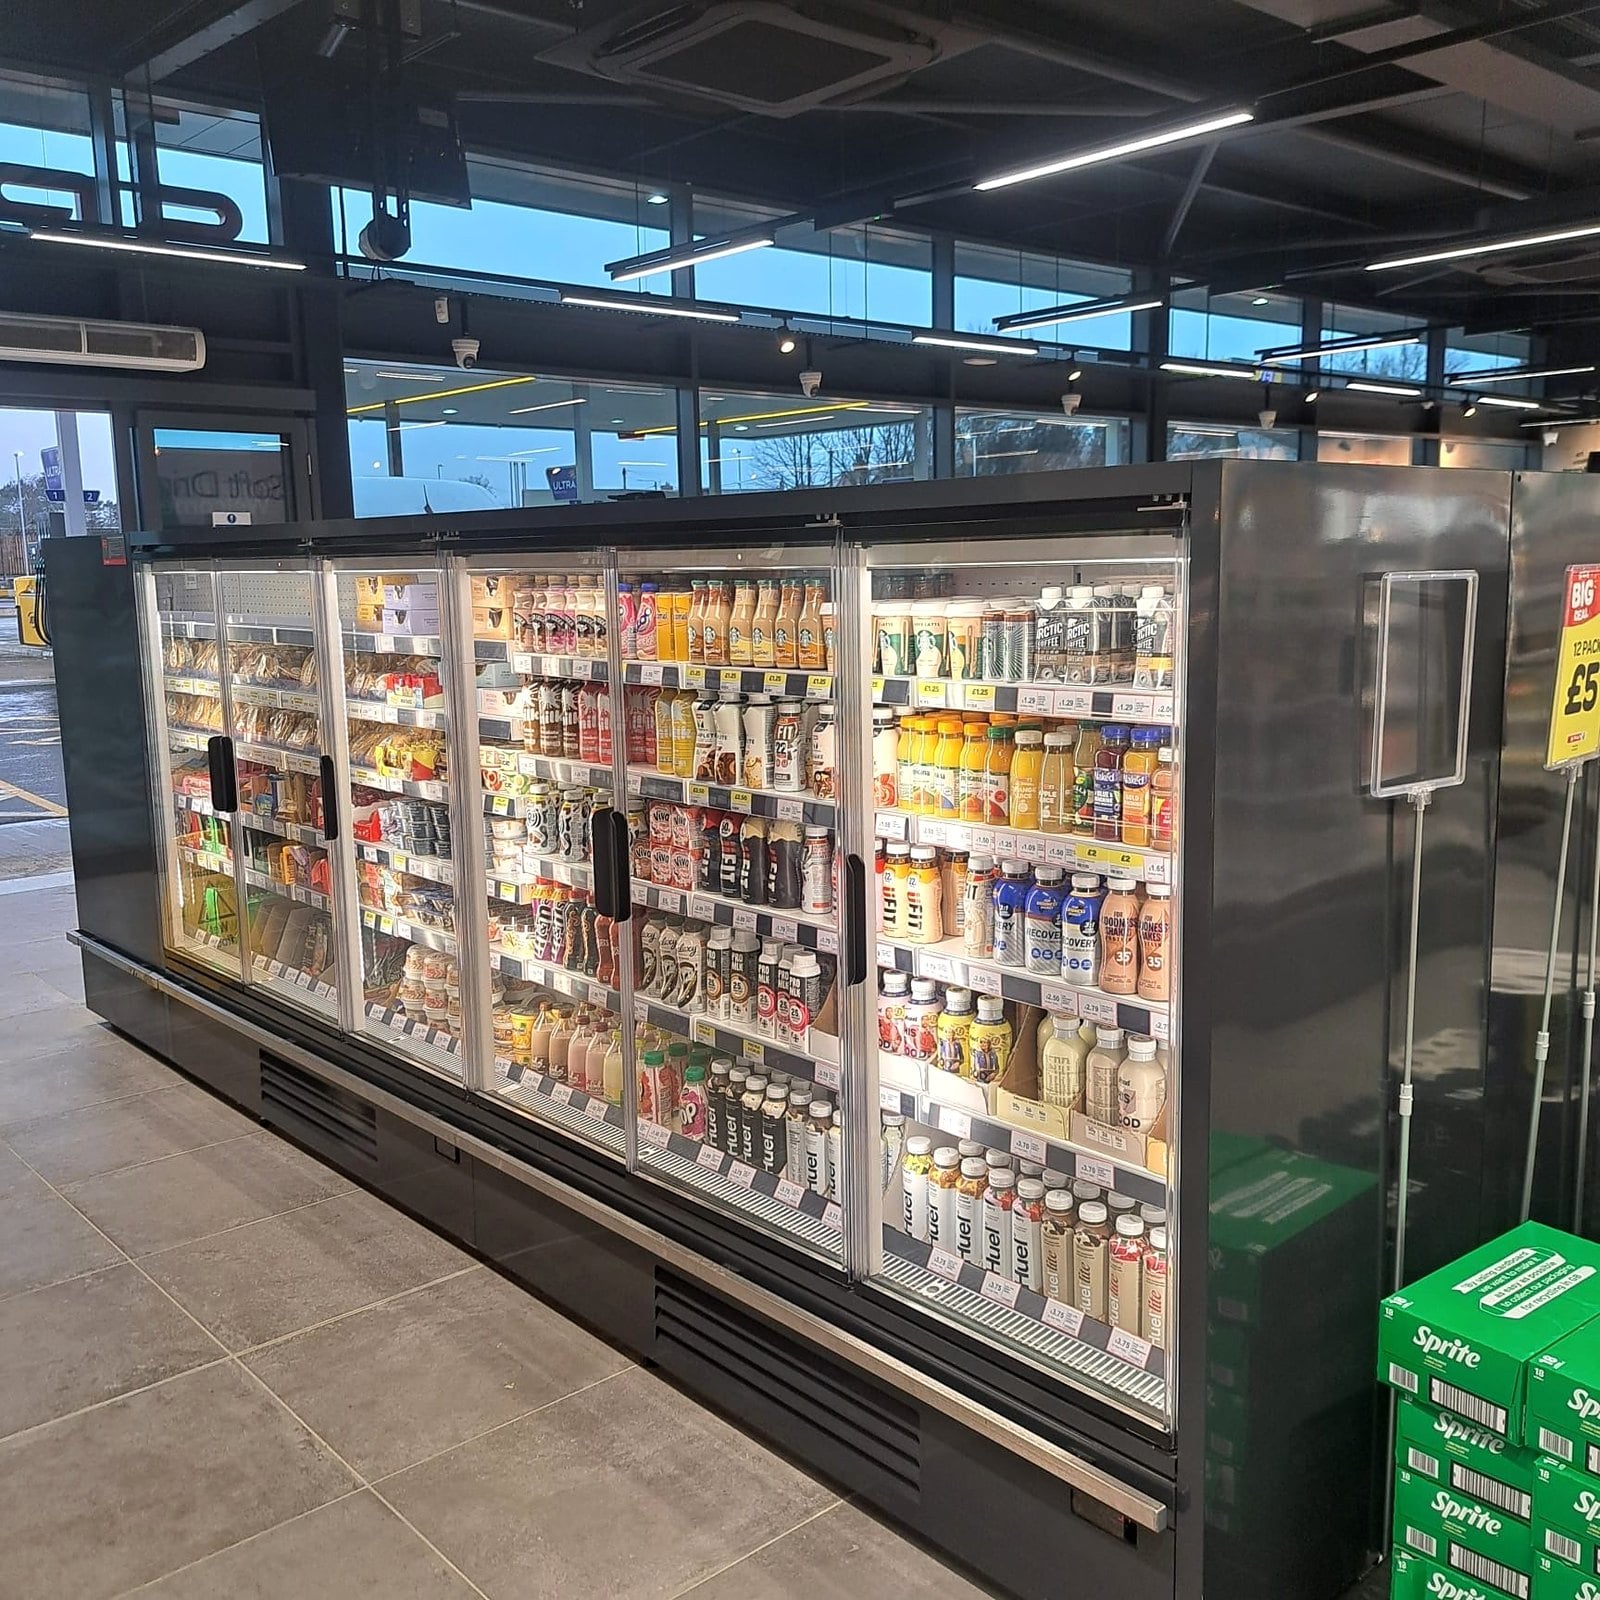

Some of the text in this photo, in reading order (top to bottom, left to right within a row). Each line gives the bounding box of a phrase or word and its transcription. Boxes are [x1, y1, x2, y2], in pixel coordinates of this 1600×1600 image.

[552, 480, 576, 490] ULTRA
[87, 492, 93, 500] 2
[1572, 579, 1595, 608] BIG
[1574, 641, 1582, 656] 12
[924, 685, 939, 693] £1.25
[1565, 662, 1600, 715] £5
[776, 742, 786, 754] 22
[1087, 849, 1097, 857] £2
[1121, 855, 1131, 863] £2
[1116, 951, 1132, 962] 35
[1147, 956, 1163, 967] 35
[985, 1227, 1002, 1273] Huel
[1014, 1239, 1030, 1289] Huel
[1412, 1325, 1481, 1368] Sprite
[1535, 1368, 1544, 1378] 18
[1567, 1388, 1600, 1419] Sp
[1433, 1412, 1505, 1455] Sprite
[1402, 1471, 1410, 1481] 18
[1539, 1468, 1550, 1479] 18
[1431, 1491, 1502, 1536] Sprite
[1541, 1557, 1551, 1569] 18
[1427, 1572, 1486, 1600] Spri
